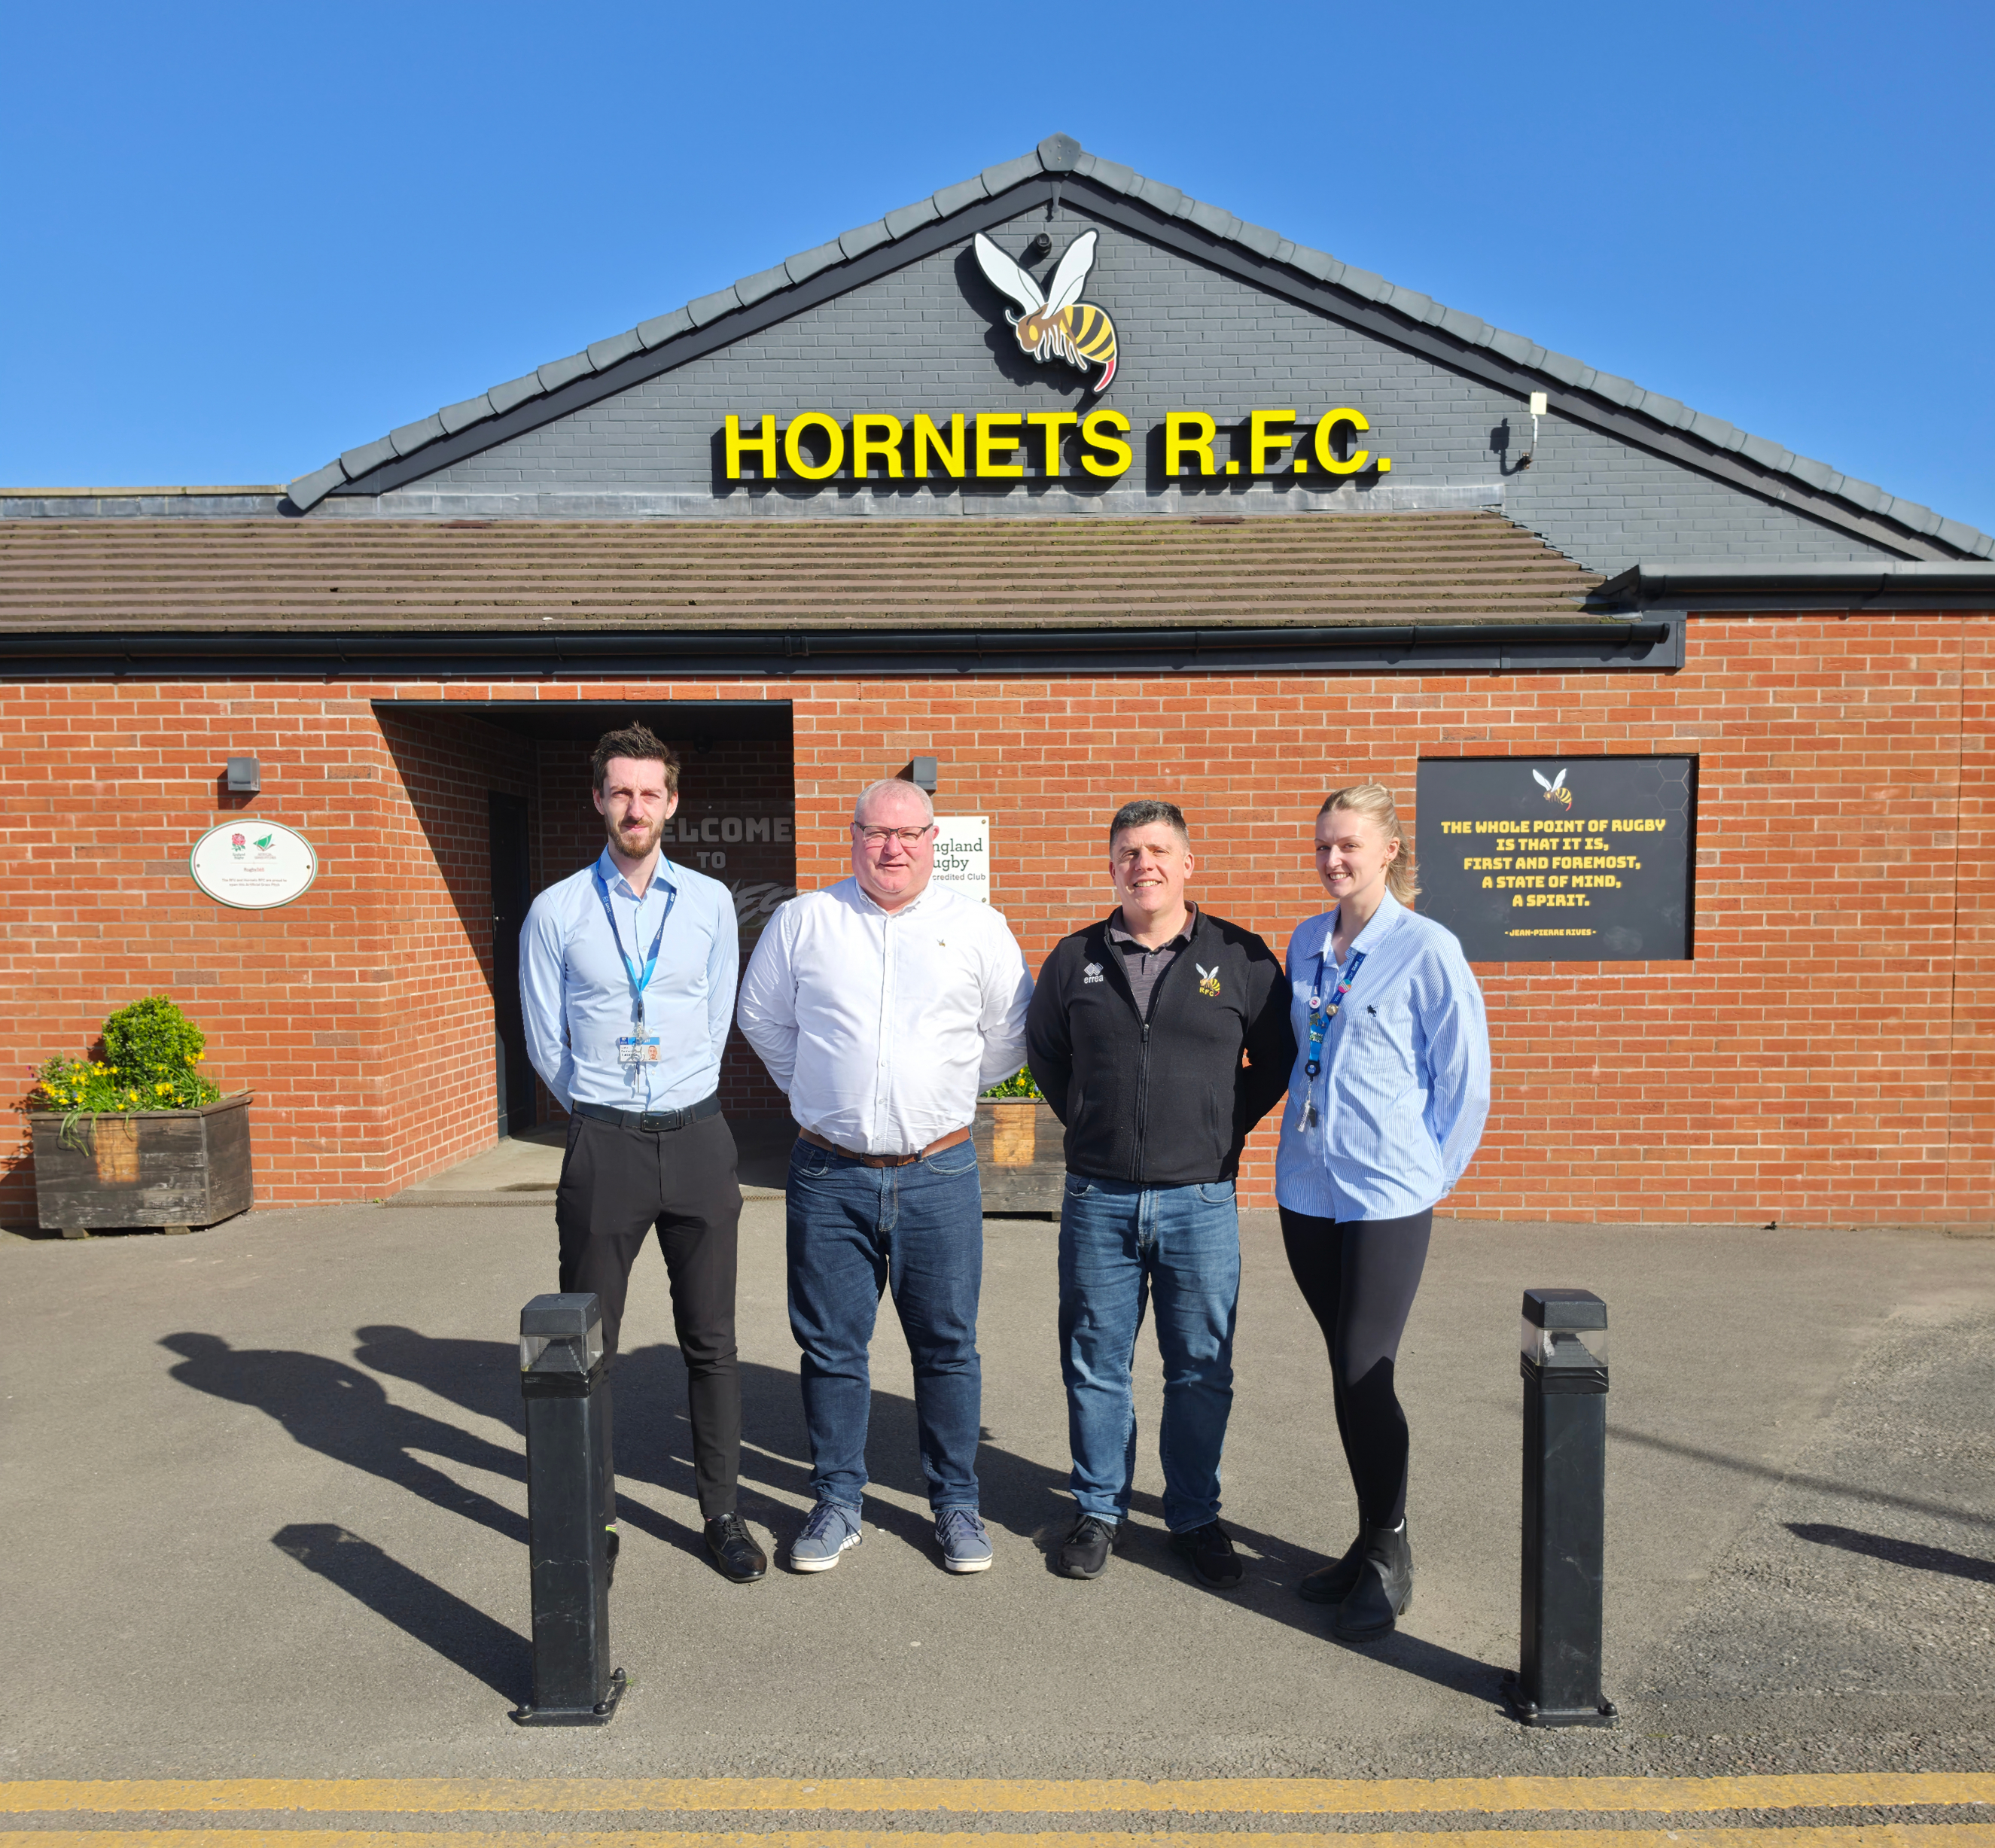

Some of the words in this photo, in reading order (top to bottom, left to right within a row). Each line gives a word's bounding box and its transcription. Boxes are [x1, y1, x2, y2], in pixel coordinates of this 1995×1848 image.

[725, 409, 1133, 480] HORNETS
[1166, 407, 1391, 476] R.F.C.
[661, 817, 793, 843] ELCOME
[1441, 821, 1472, 833] THE
[1476, 820, 1530, 833] WHOLE
[1534, 820, 1585, 833] POINT
[1588, 820, 1609, 832] OF
[1612, 819, 1666, 832] RUGBY
[933, 838, 983, 855] ngland
[1497, 839, 1515, 851] IS
[1518, 838, 1560, 851] THAT
[1563, 838, 1582, 850] IT
[1585, 837, 1610, 851] IS,
[696, 851, 726, 869] TO
[933, 854, 969, 871] ugby
[1464, 857, 1512, 870] FIRST
[1515, 857, 1549, 869] AND
[1552, 856, 1641, 870] FOREMOST,
[1482, 876, 1493, 888] A
[1497, 875, 1545, 888] STATE
[1549, 875, 1569, 887] OF
[1572, 875, 1622, 889] MIND,
[1512, 894, 1524, 907] A
[1527, 894, 1590, 907] SPIRIT.
[1199, 987, 1214, 997] RFC
